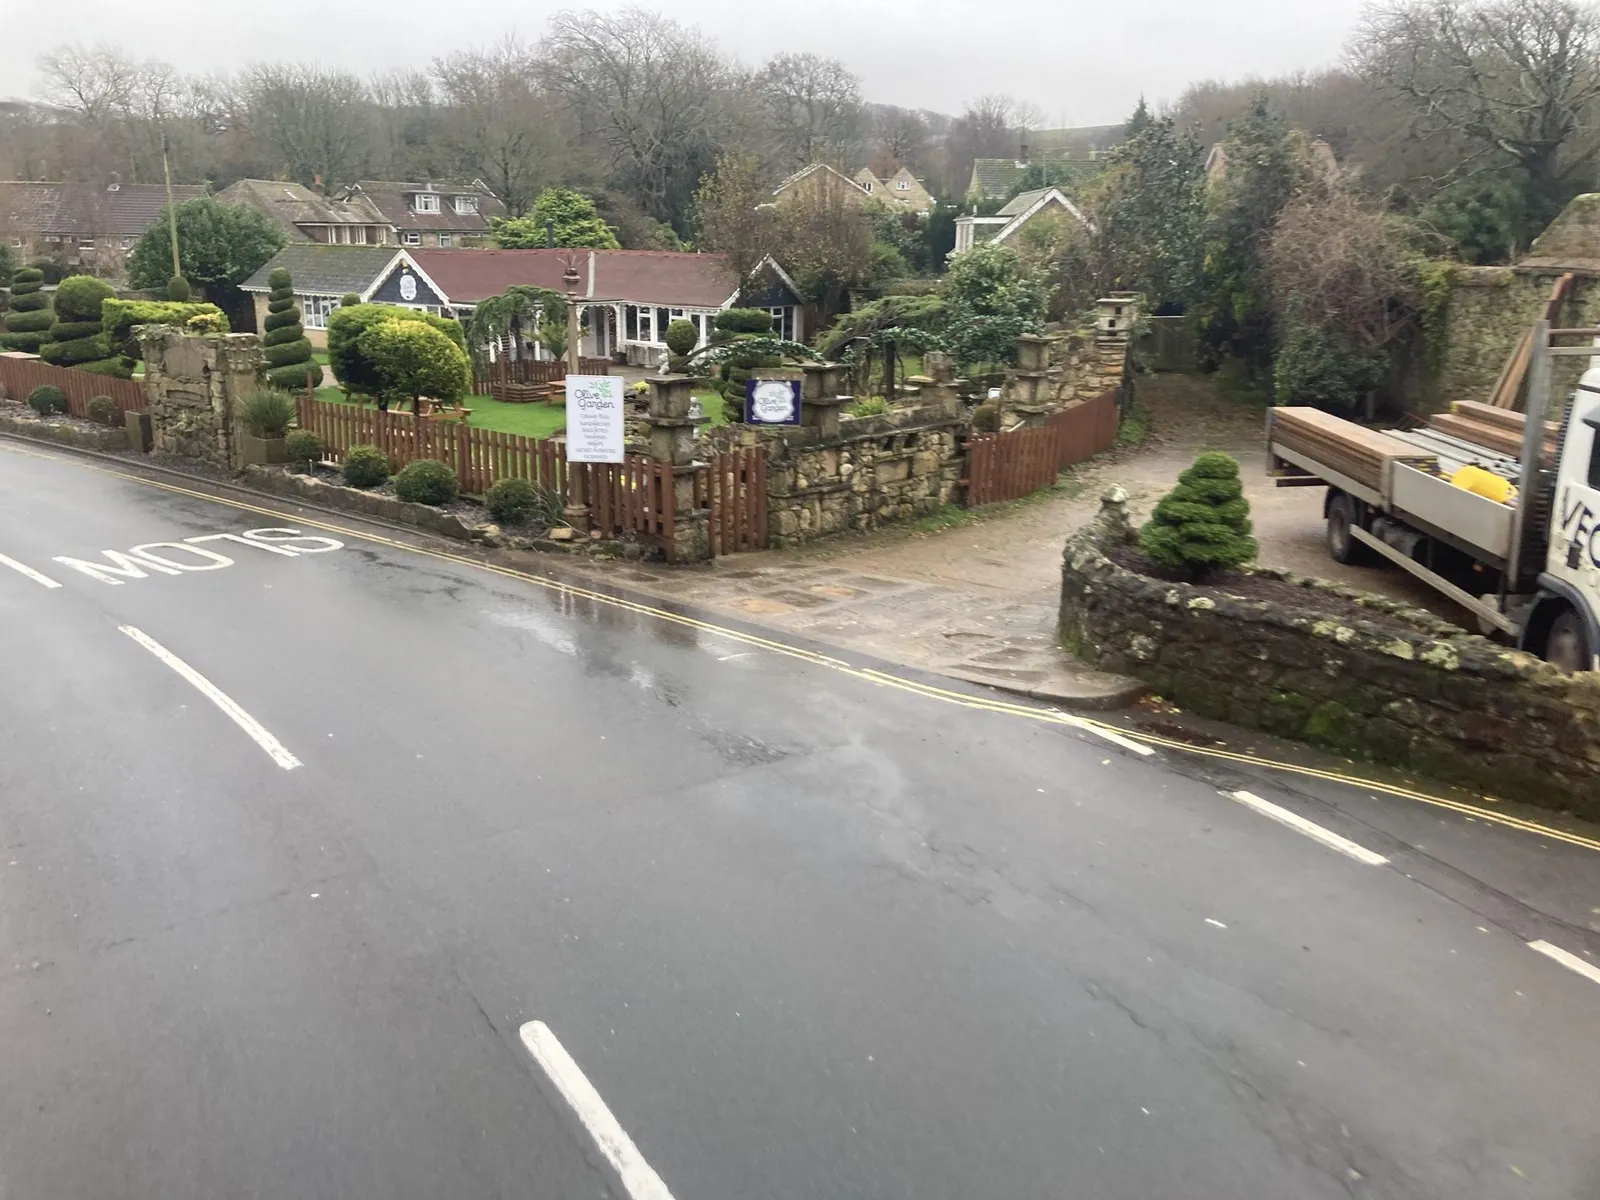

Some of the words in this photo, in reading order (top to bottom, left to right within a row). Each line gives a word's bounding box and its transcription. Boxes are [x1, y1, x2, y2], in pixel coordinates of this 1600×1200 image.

[574, 389, 600, 399] Olive
[577, 398, 615, 410] Garden
[51, 527, 345, 586] SLOW
